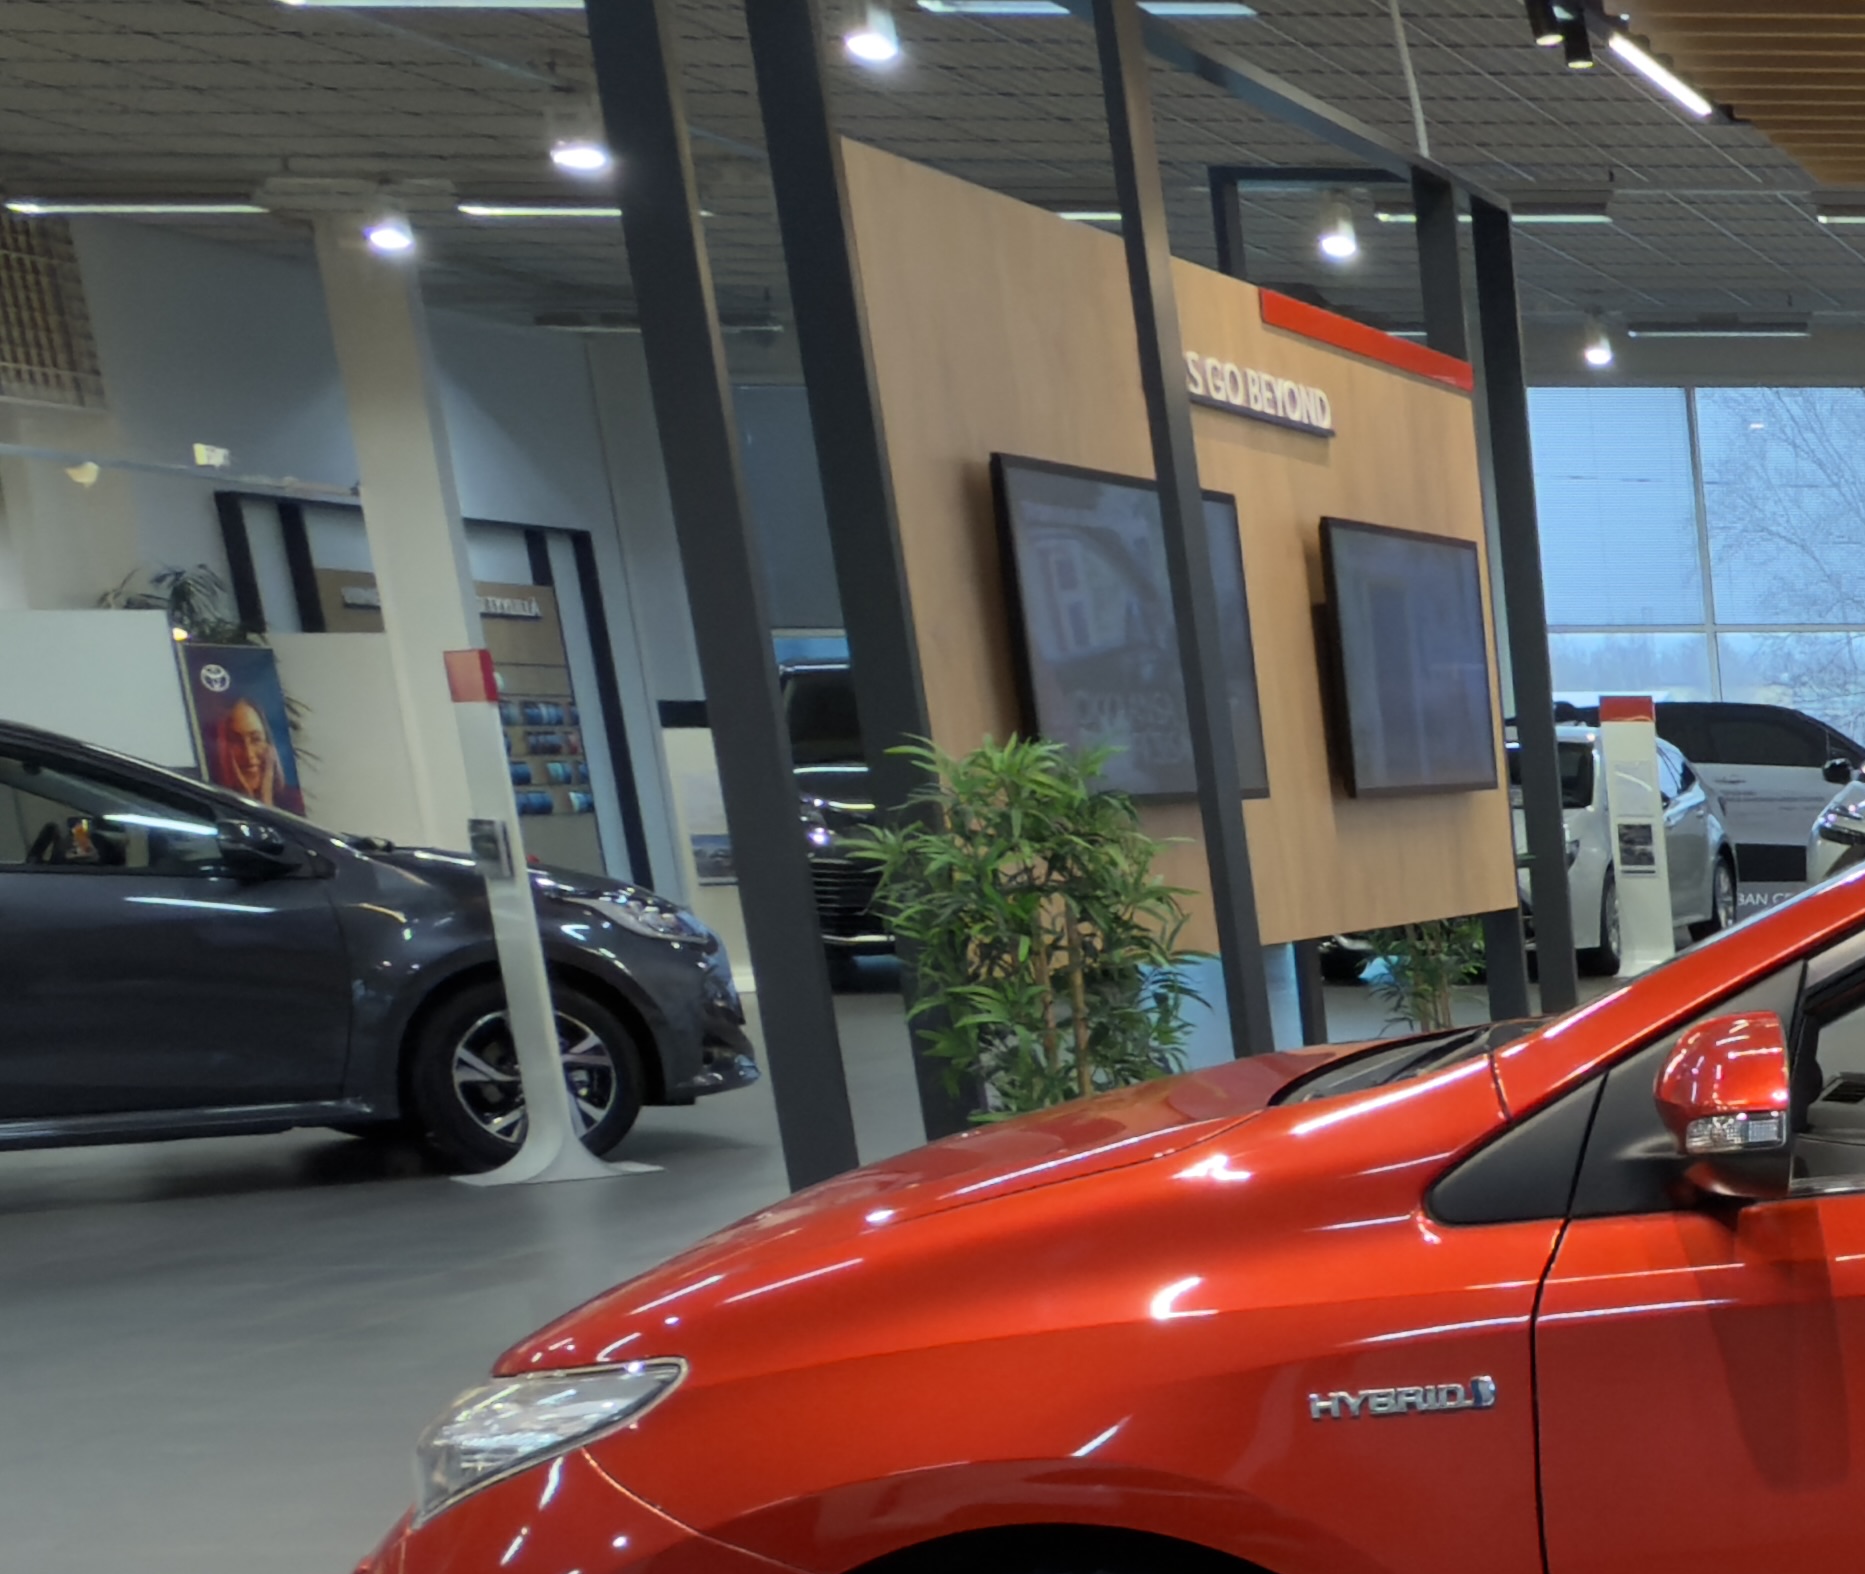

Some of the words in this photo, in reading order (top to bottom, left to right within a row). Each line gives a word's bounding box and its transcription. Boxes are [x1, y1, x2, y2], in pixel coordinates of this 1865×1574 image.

[1205, 357, 1244, 405] GO
[1246, 367, 1332, 429] BEYOND
[1308, 1383, 1467, 1420] HYBRID
